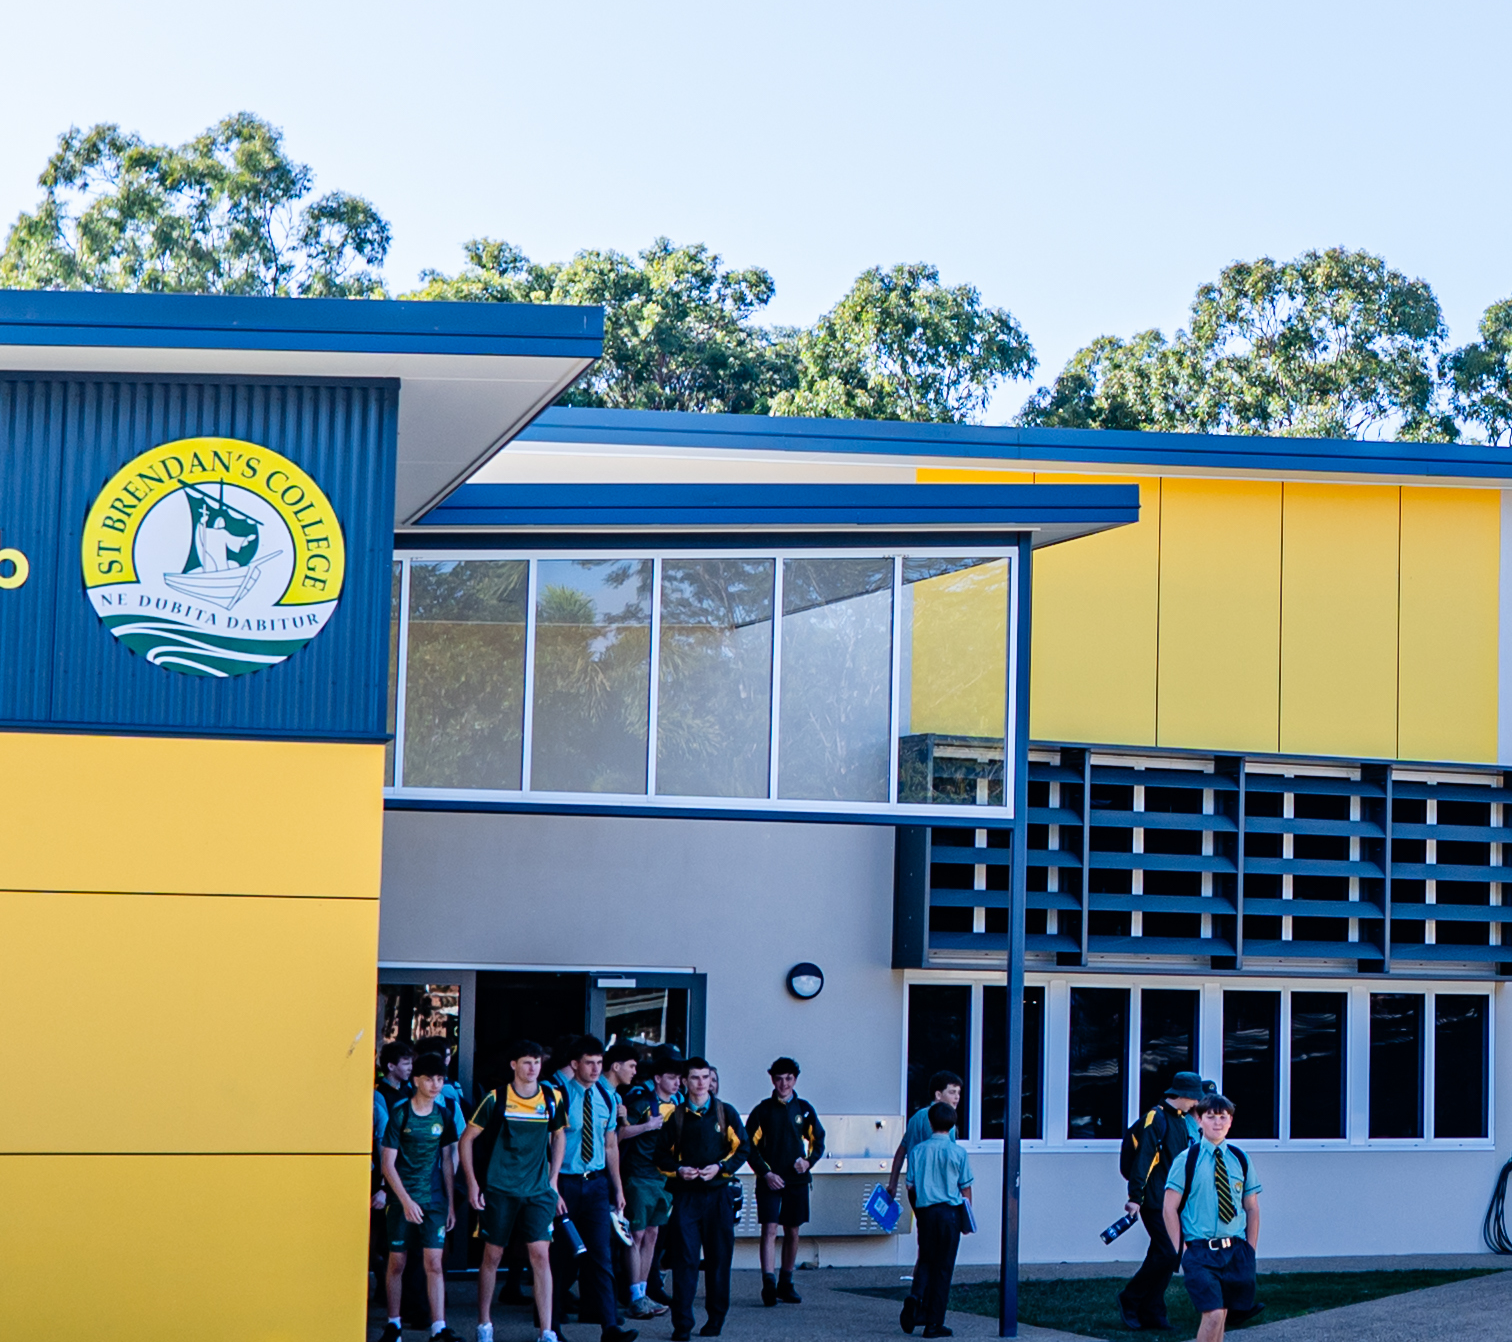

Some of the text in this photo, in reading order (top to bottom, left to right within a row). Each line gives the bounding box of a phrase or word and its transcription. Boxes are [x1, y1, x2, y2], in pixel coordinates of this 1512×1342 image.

[97, 450, 332, 592] ST BRENDAN'S COLLEGE
[101, 594, 320, 631] NE DUBITA DABITUR
